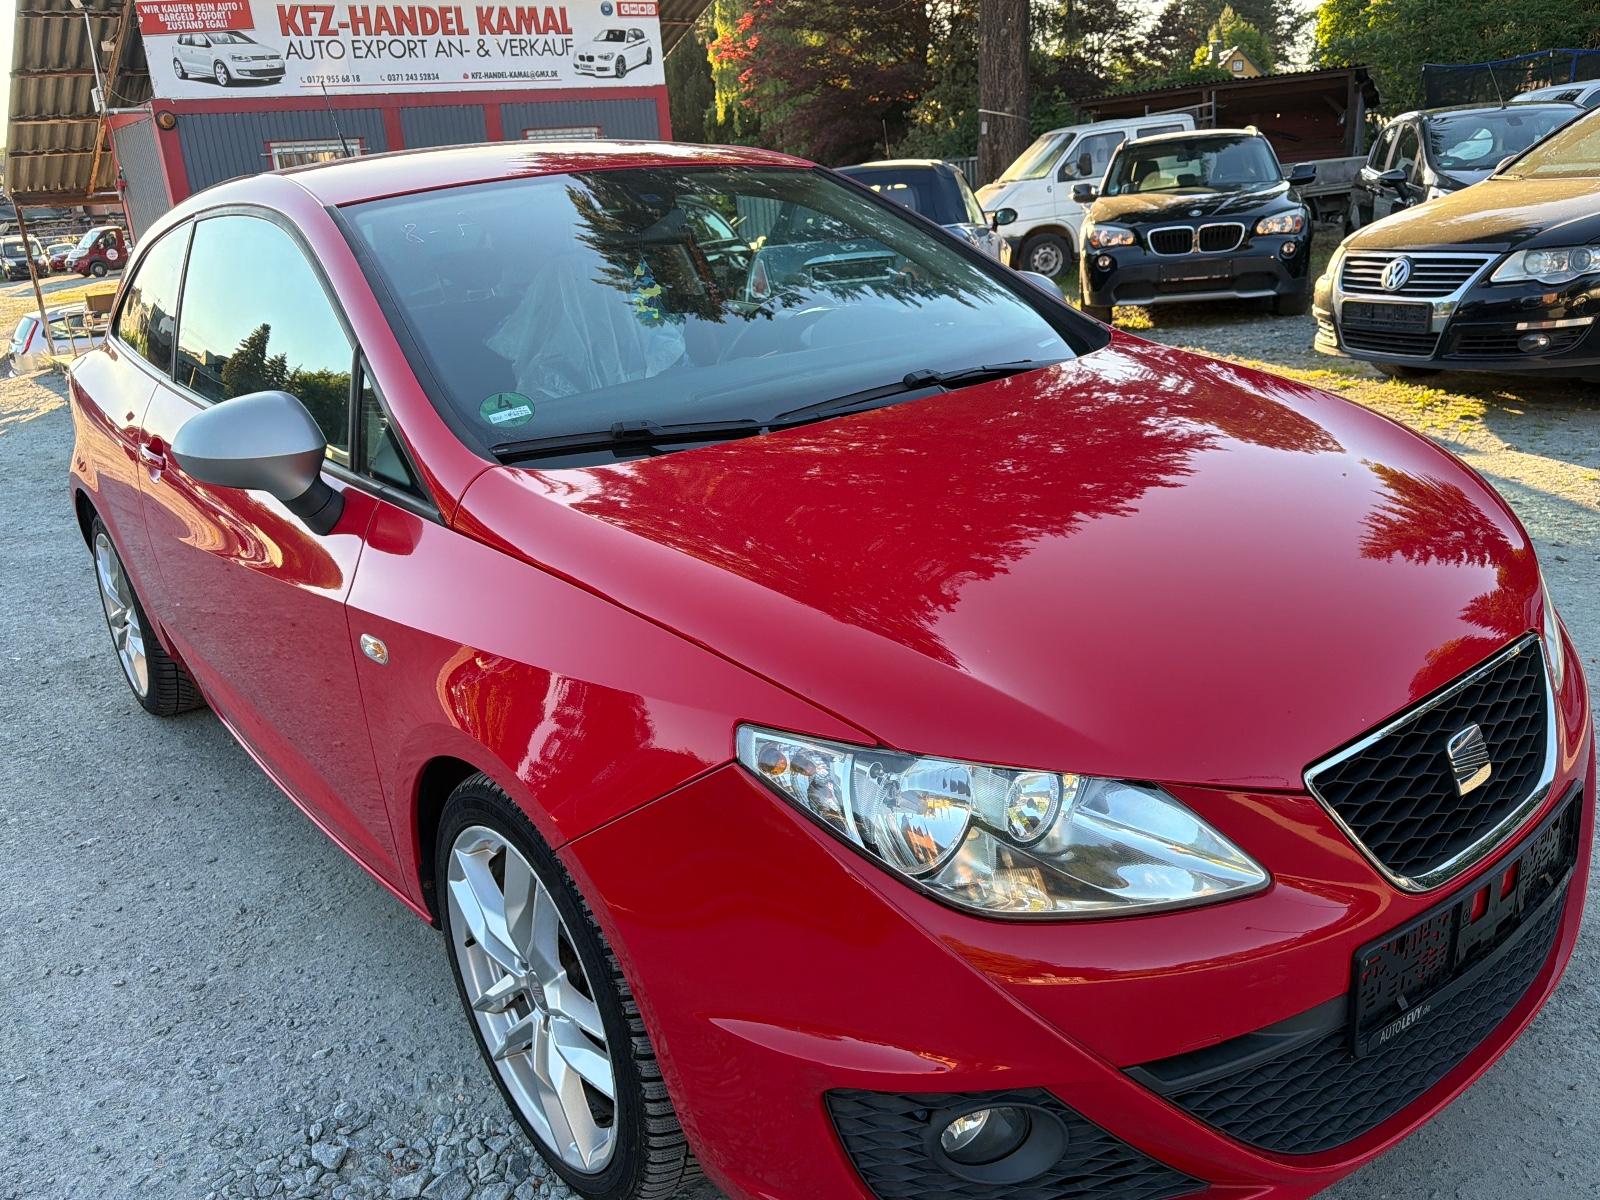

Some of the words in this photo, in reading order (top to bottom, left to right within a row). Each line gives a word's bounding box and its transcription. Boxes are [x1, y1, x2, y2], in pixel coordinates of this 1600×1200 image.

[141, 4, 159, 14] WIR
[161, 3, 194, 13] KAUFEN
[195, 3, 215, 12] DEIN
[217, 2, 238, 11] AUTO
[158, 12, 195, 22] BARGELD
[196, 11, 226, 20] SOFORT
[276, 4, 469, 36] KFZ-HANDEL
[476, 5, 573, 35] KAMAL
[166, 21, 204, 31] ZUSTAND
[205, 20, 228, 29] EGAL!
[286, 39, 346, 60] AUTO
[351, 38, 428, 59] EXPORT
[434, 38, 470, 58] AN-
[476, 38, 492, 58] &
[495, 38, 574, 57] VERKAUF
[326, 74, 339, 83] 955
[387, 73, 404, 82] 0371
[405, 73, 418, 81] 243
[419, 72, 440, 81] 52834
[471, 70, 559, 80] KFZ-HANDEL-KAMAL@GMX.DE
